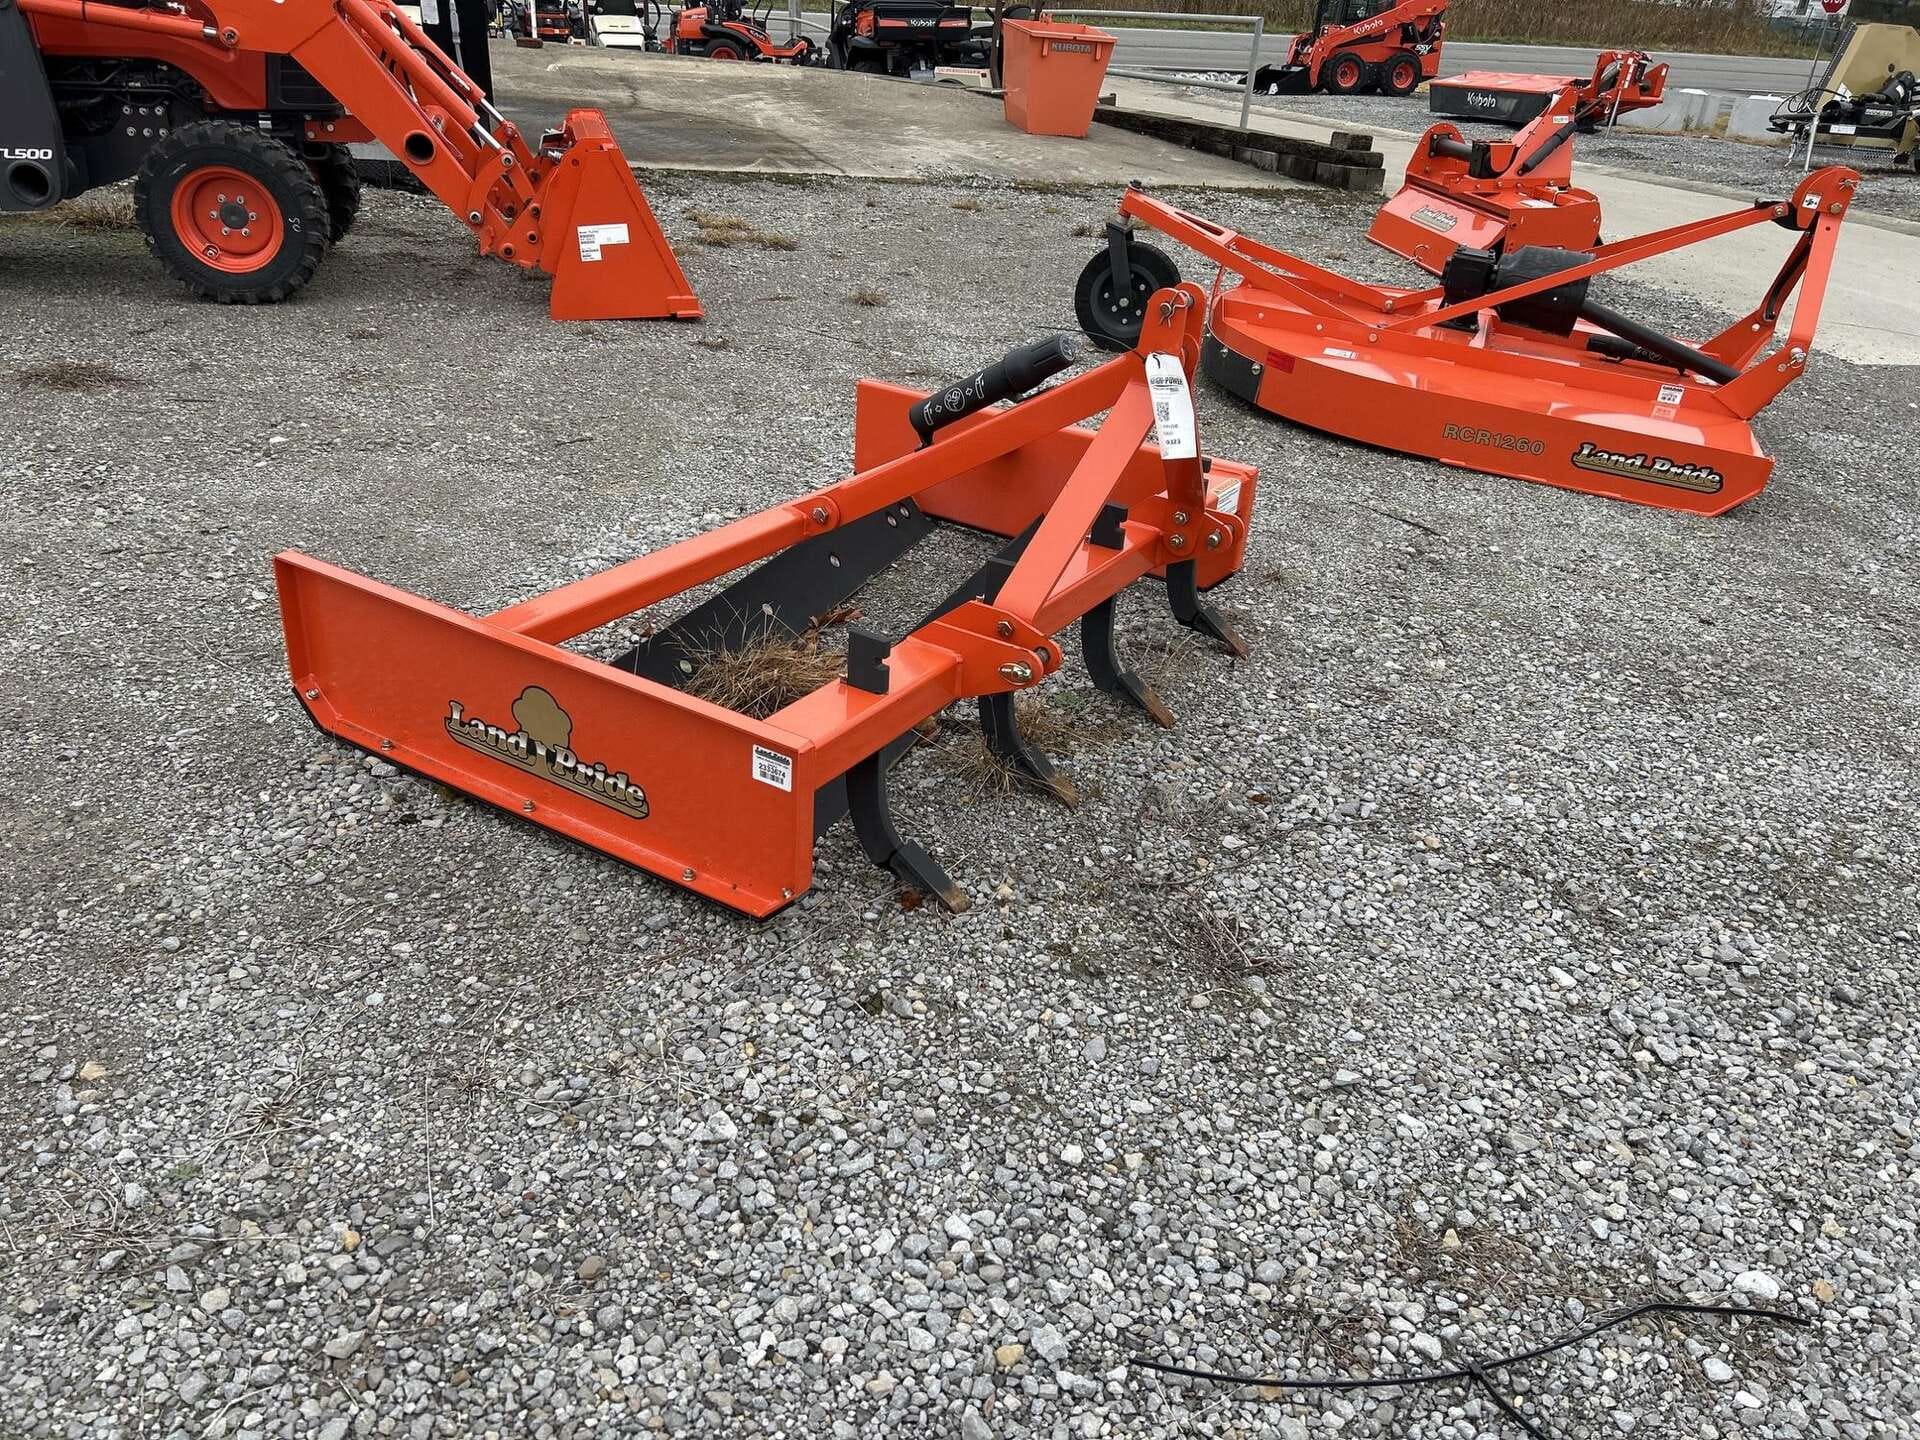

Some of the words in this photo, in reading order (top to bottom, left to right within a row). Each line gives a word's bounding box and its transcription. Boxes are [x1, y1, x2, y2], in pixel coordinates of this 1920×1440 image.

[1353, 19, 1384, 35] Kubota
[1052, 42, 1091, 53] KUBOTA
[1467, 91, 1496, 108] Kubota
[1442, 423, 1546, 456] RCR1260
[1576, 442, 1647, 471] Land
[1648, 457, 1723, 487] Pride
[448, 700, 530, 760] Land
[550, 744, 646, 808] Pride
